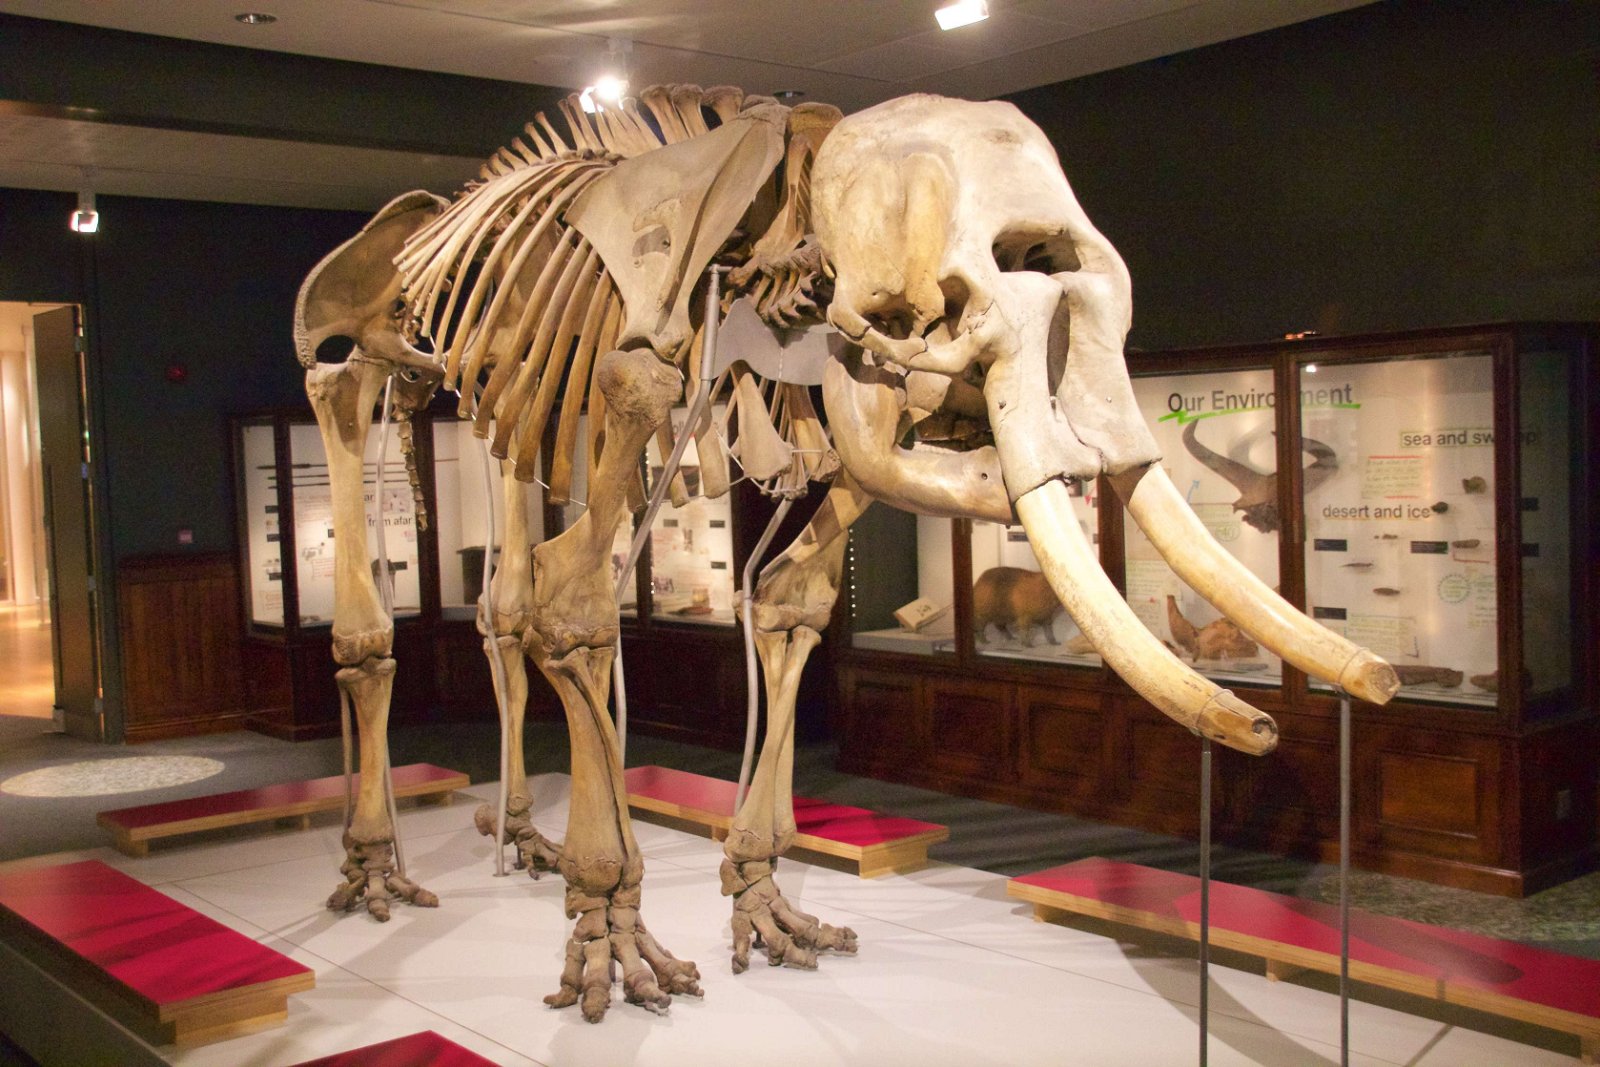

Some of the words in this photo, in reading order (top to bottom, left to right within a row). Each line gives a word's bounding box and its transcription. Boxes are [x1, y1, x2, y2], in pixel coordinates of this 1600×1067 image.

[1168, 393, 1204, 412] Our
[1212, 384, 1352, 409] Enviroment
[1404, 434, 1432, 446] sea
[1437, 430, 1467, 445] and
[1472, 431, 1536, 446] swp
[1322, 503, 1370, 518] desert
[1374, 503, 1401, 518] and
[1407, 504, 1430, 518] ice
[368, 518, 391, 527] frm
[393, 516, 413, 526] afar
